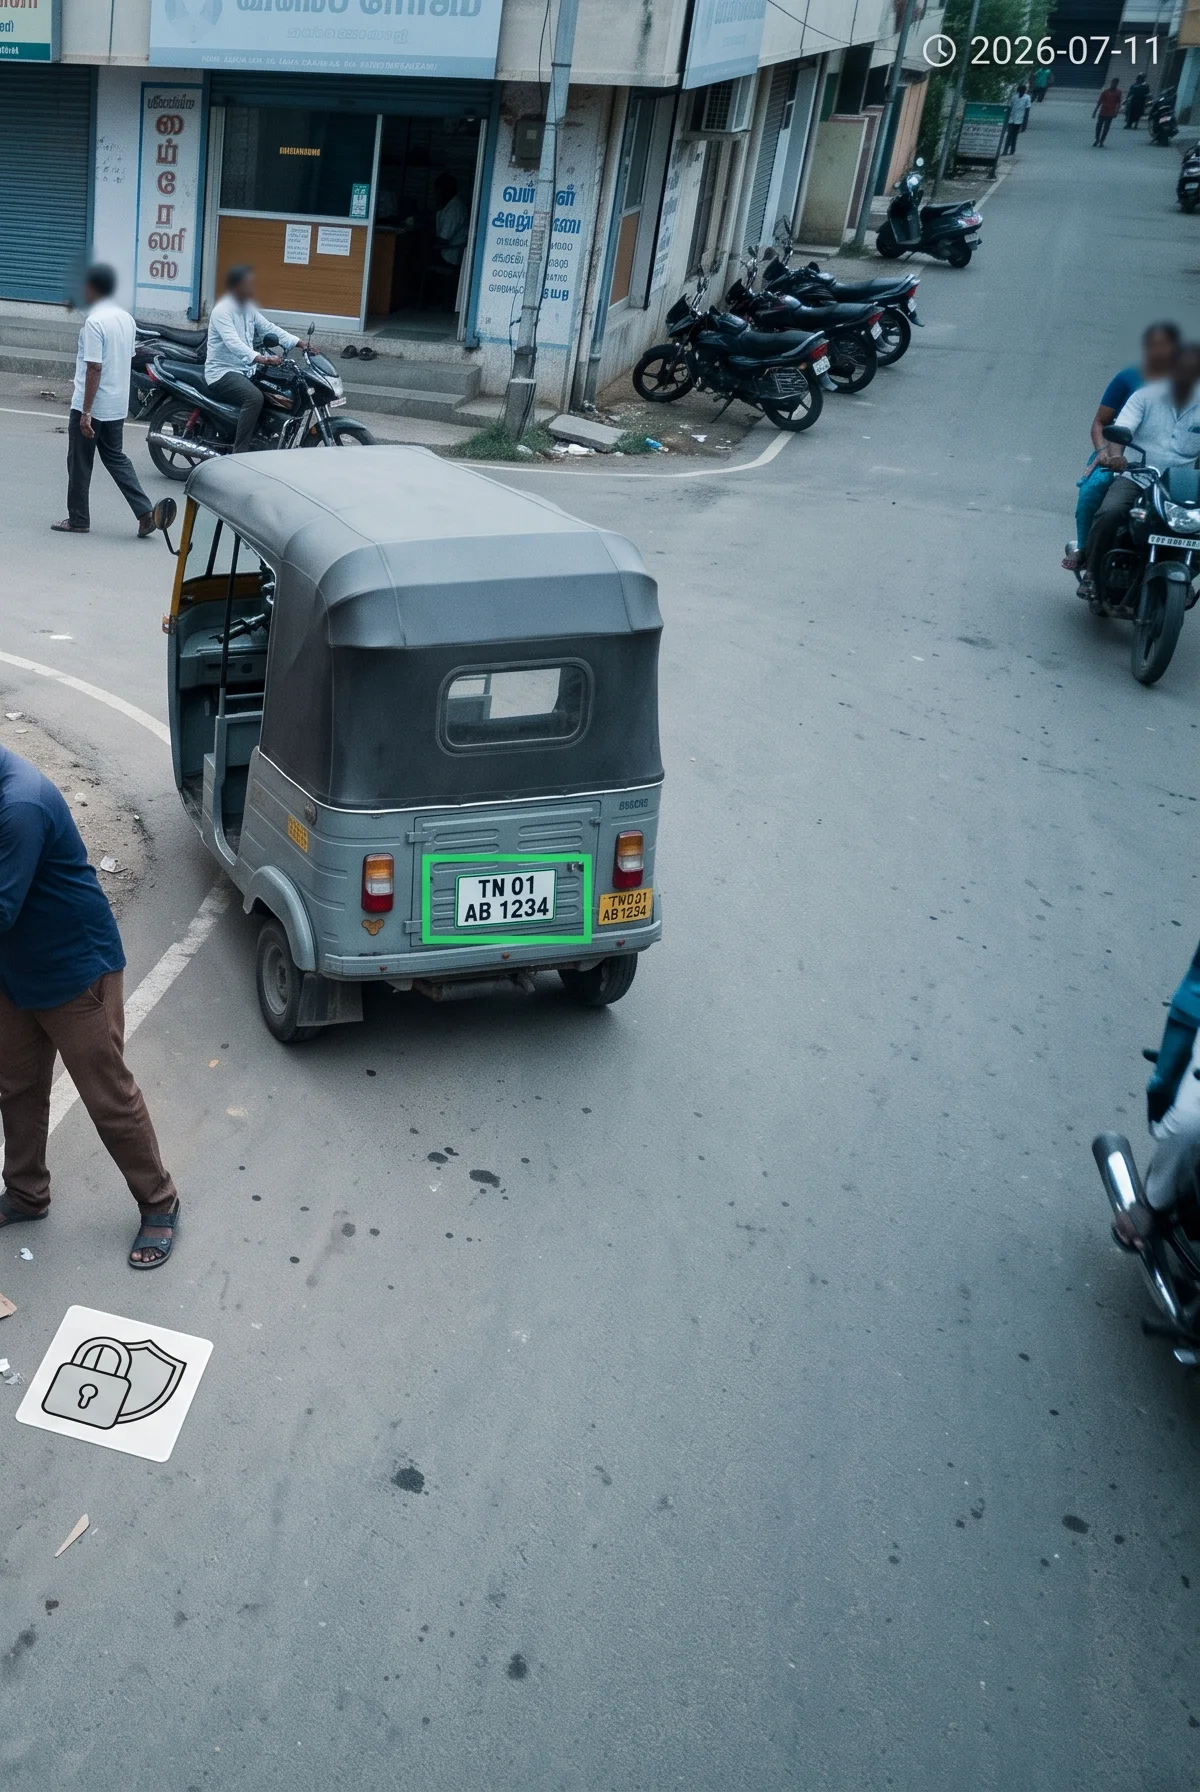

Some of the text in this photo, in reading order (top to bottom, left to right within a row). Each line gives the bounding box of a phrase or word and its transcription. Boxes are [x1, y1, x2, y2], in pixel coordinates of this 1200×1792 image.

[478, 875, 534, 898] TN 01
[464, 896, 549, 922] AB 1234
